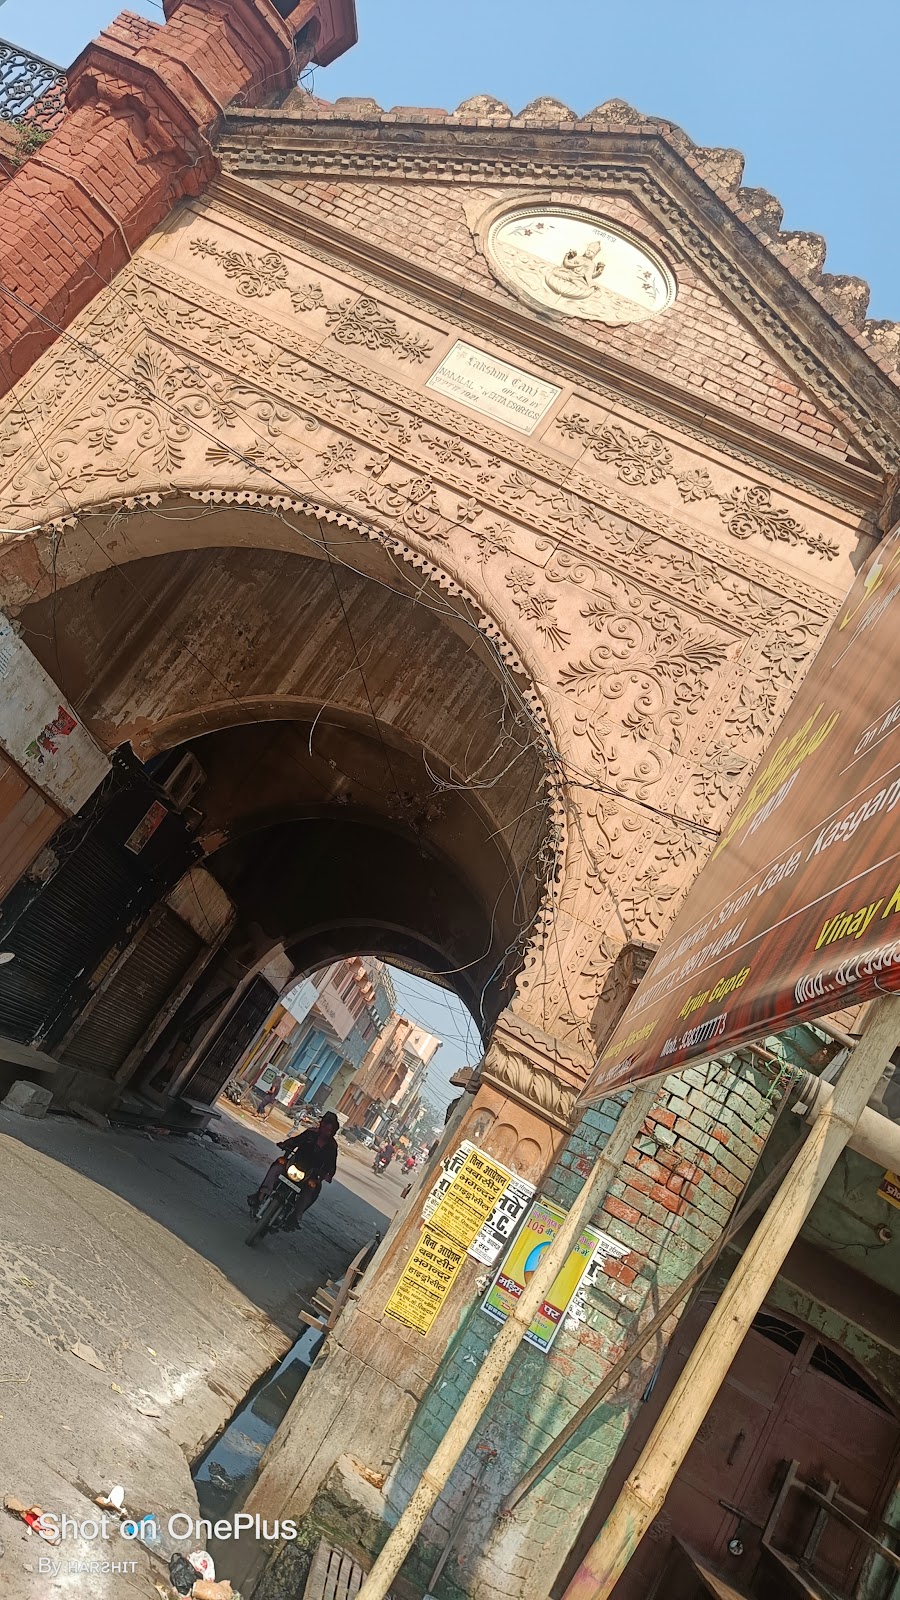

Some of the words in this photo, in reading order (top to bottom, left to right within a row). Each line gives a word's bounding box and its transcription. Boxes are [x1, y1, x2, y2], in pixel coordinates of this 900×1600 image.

[739, 768, 800, 847] FOOD
[712, 884, 758, 931] Soron
[757, 851, 802, 898] Gate,
[815, 897, 885, 951] Vinay
[676, 989, 711, 1020] Arjun
[708, 966, 751, 1003] Gupta
[469, 1153, 484, 1169] बिना
[422, 1233, 438, 1250] बिना
[525, 1217, 546, 1235] 105
[413, 1256, 451, 1282] भगन्दर
